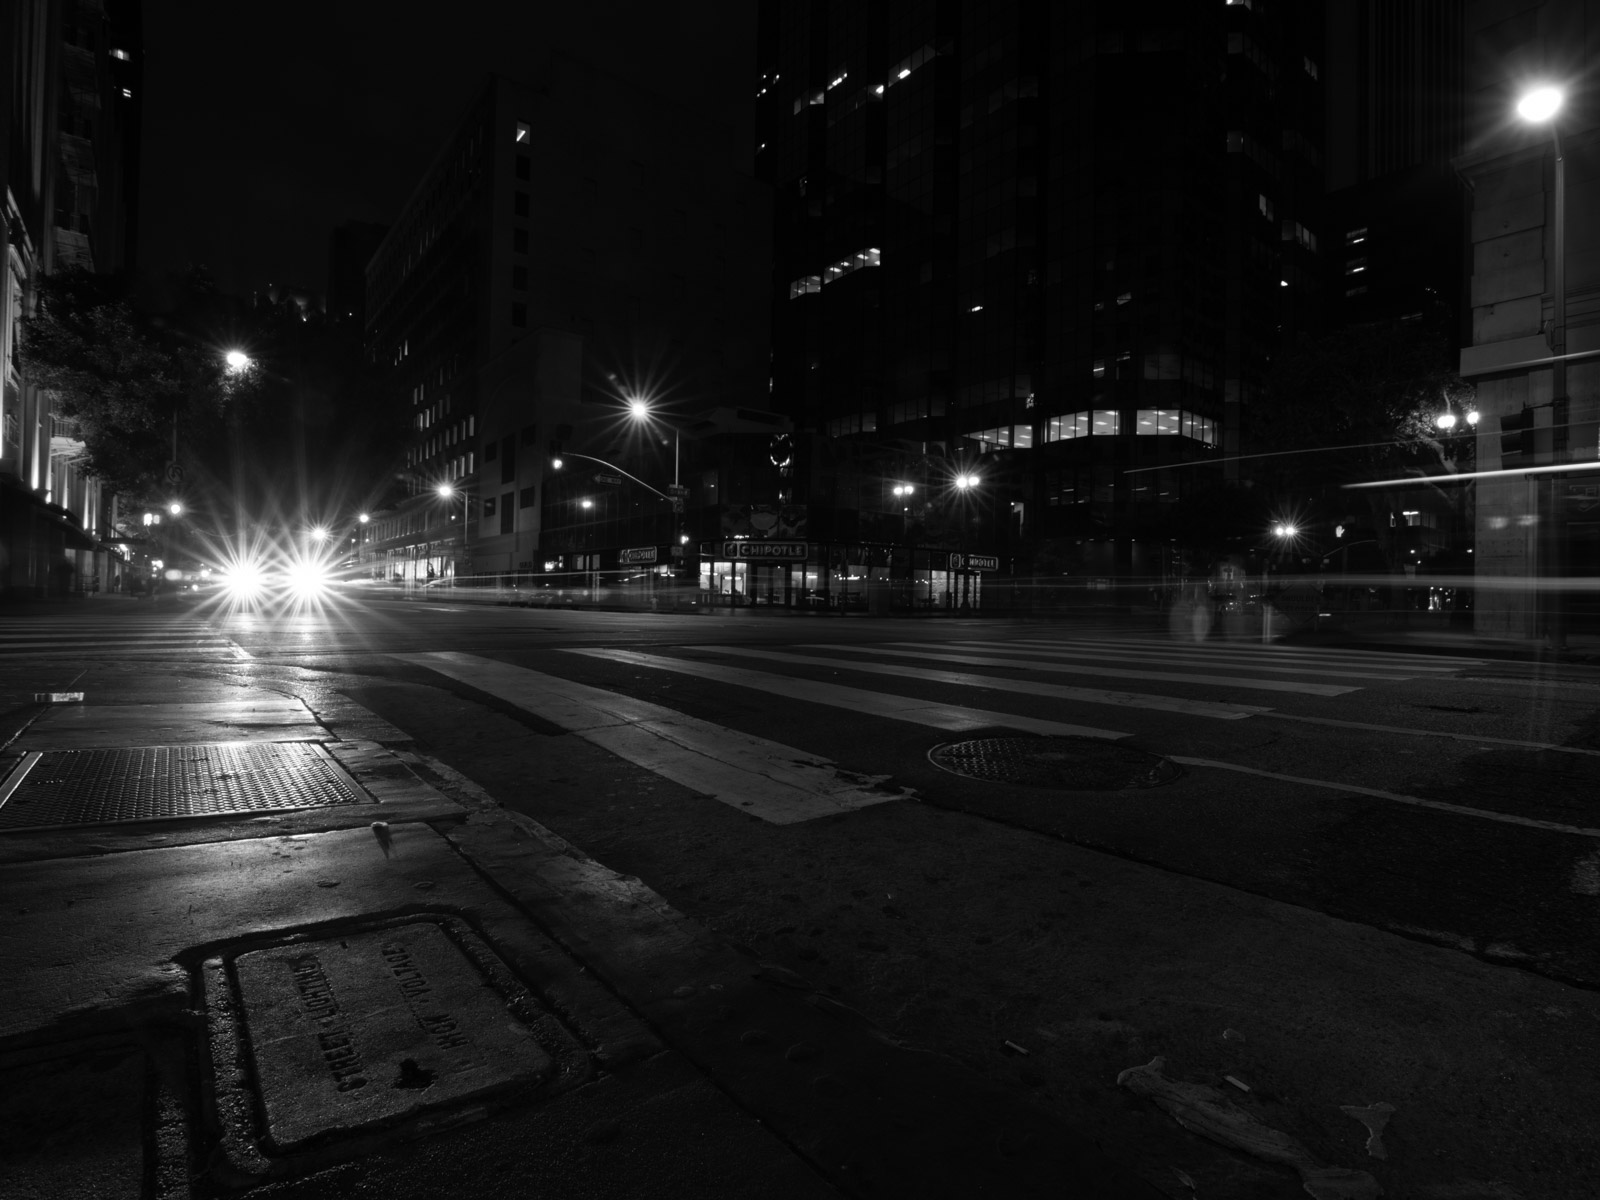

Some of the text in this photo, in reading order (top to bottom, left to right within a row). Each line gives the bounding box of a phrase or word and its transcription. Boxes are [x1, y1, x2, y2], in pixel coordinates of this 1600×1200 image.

[741, 544, 803, 556] CHIPOTLE
[382, 945, 432, 997] VOLTAGE
[318, 1030, 367, 1092] STREET
